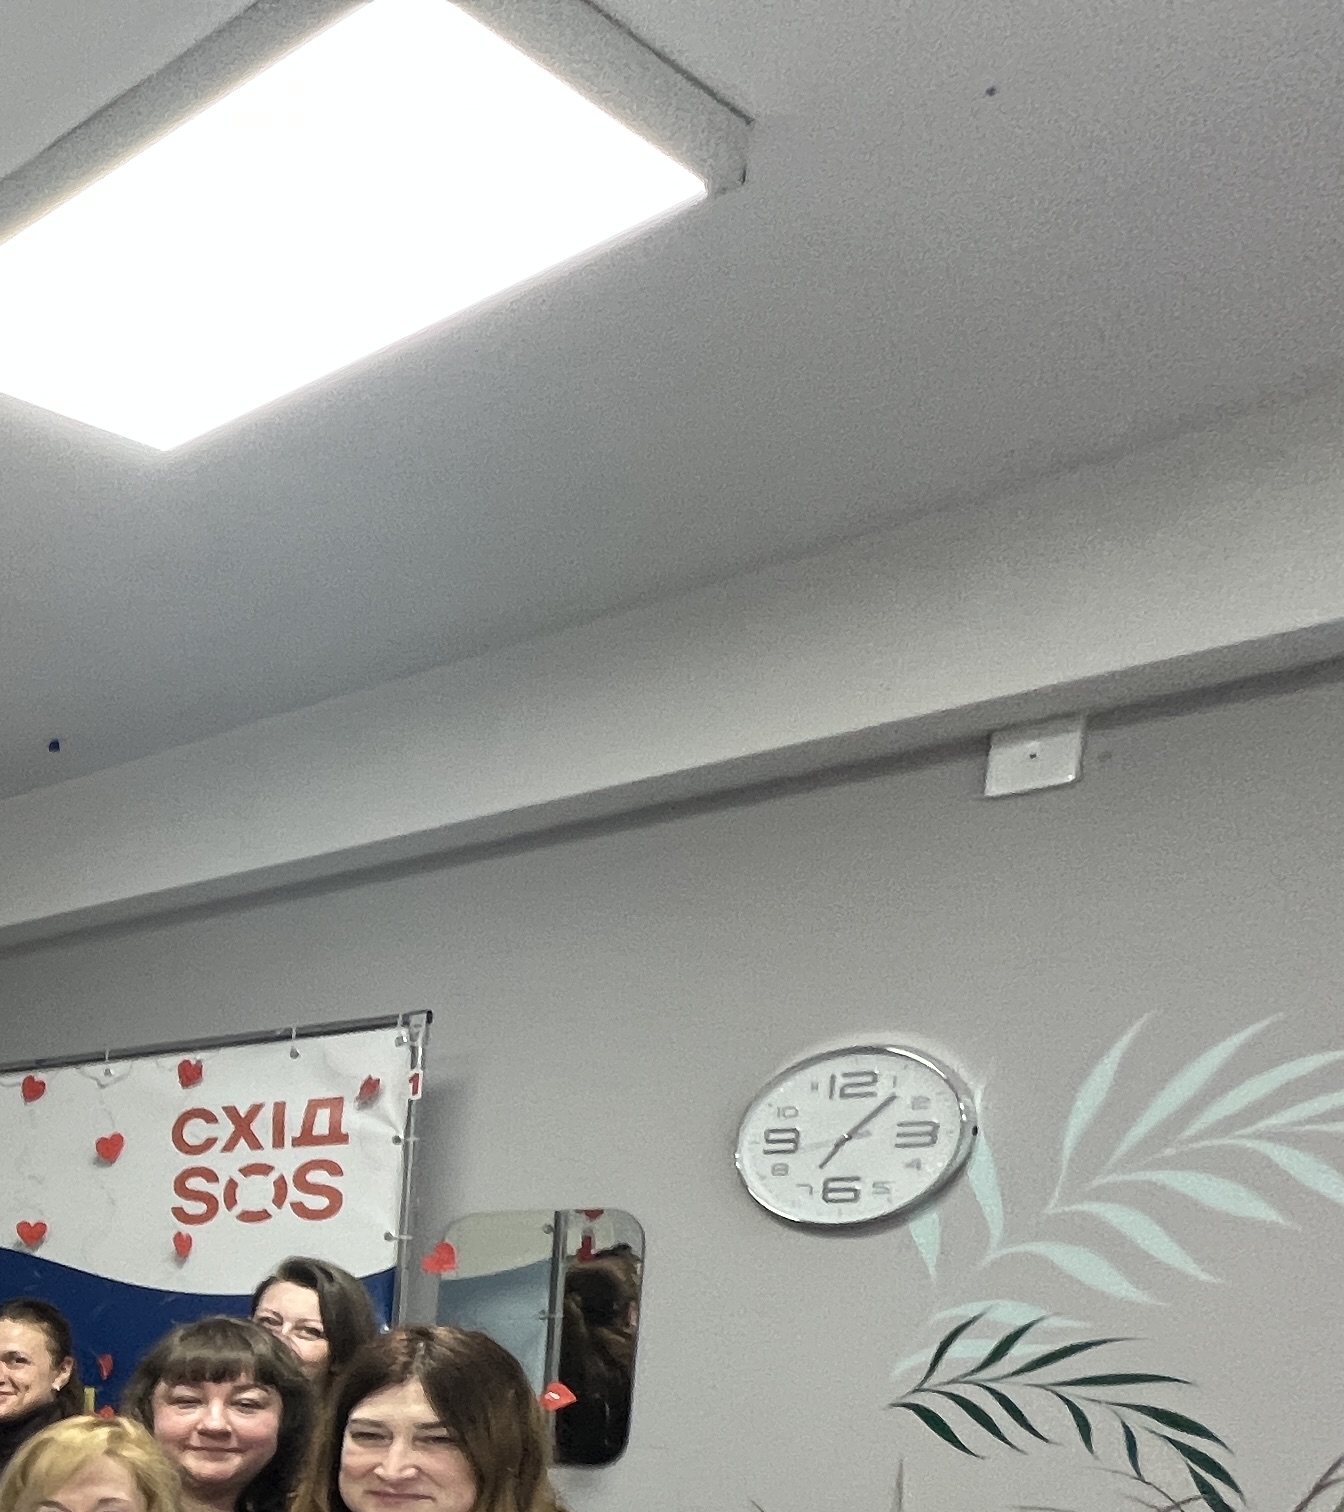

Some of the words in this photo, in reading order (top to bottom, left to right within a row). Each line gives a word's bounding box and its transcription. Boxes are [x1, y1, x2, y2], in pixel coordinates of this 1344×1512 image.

[829, 1071, 878, 1100] 12
[777, 1106, 799, 1118] 10
[171, 1096, 350, 1156] СХІД
[895, 1121, 940, 1148] 3
[764, 1127, 800, 1154] 9
[771, 1163, 789, 1176] 8
[906, 1158, 922, 1171] 4
[171, 1158, 344, 1225] SOS
[796, 1183, 813, 1195] 7
[821, 1176, 861, 1204] 6
[872, 1181, 892, 1194] 5
